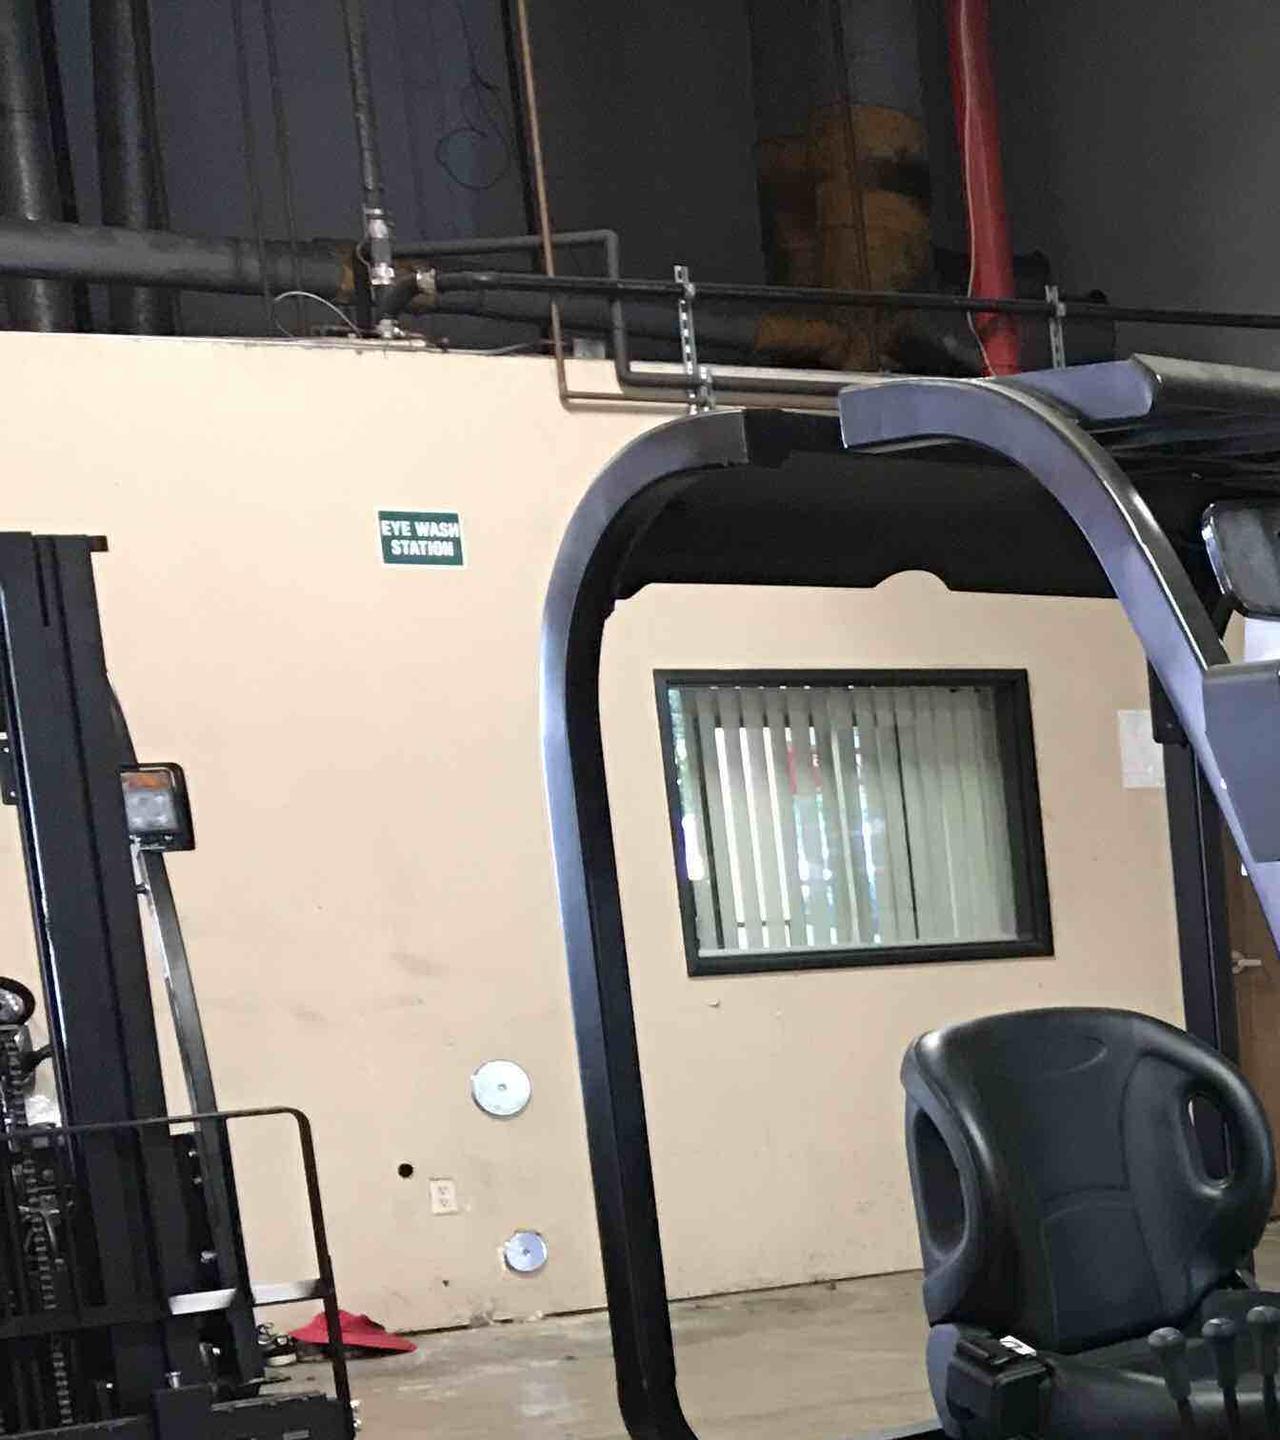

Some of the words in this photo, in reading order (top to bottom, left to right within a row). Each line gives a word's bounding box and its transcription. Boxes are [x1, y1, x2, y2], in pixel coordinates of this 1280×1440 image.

[381, 520, 412, 536] EYE
[414, 521, 460, 538] WASH
[390, 539, 454, 557] STATION
